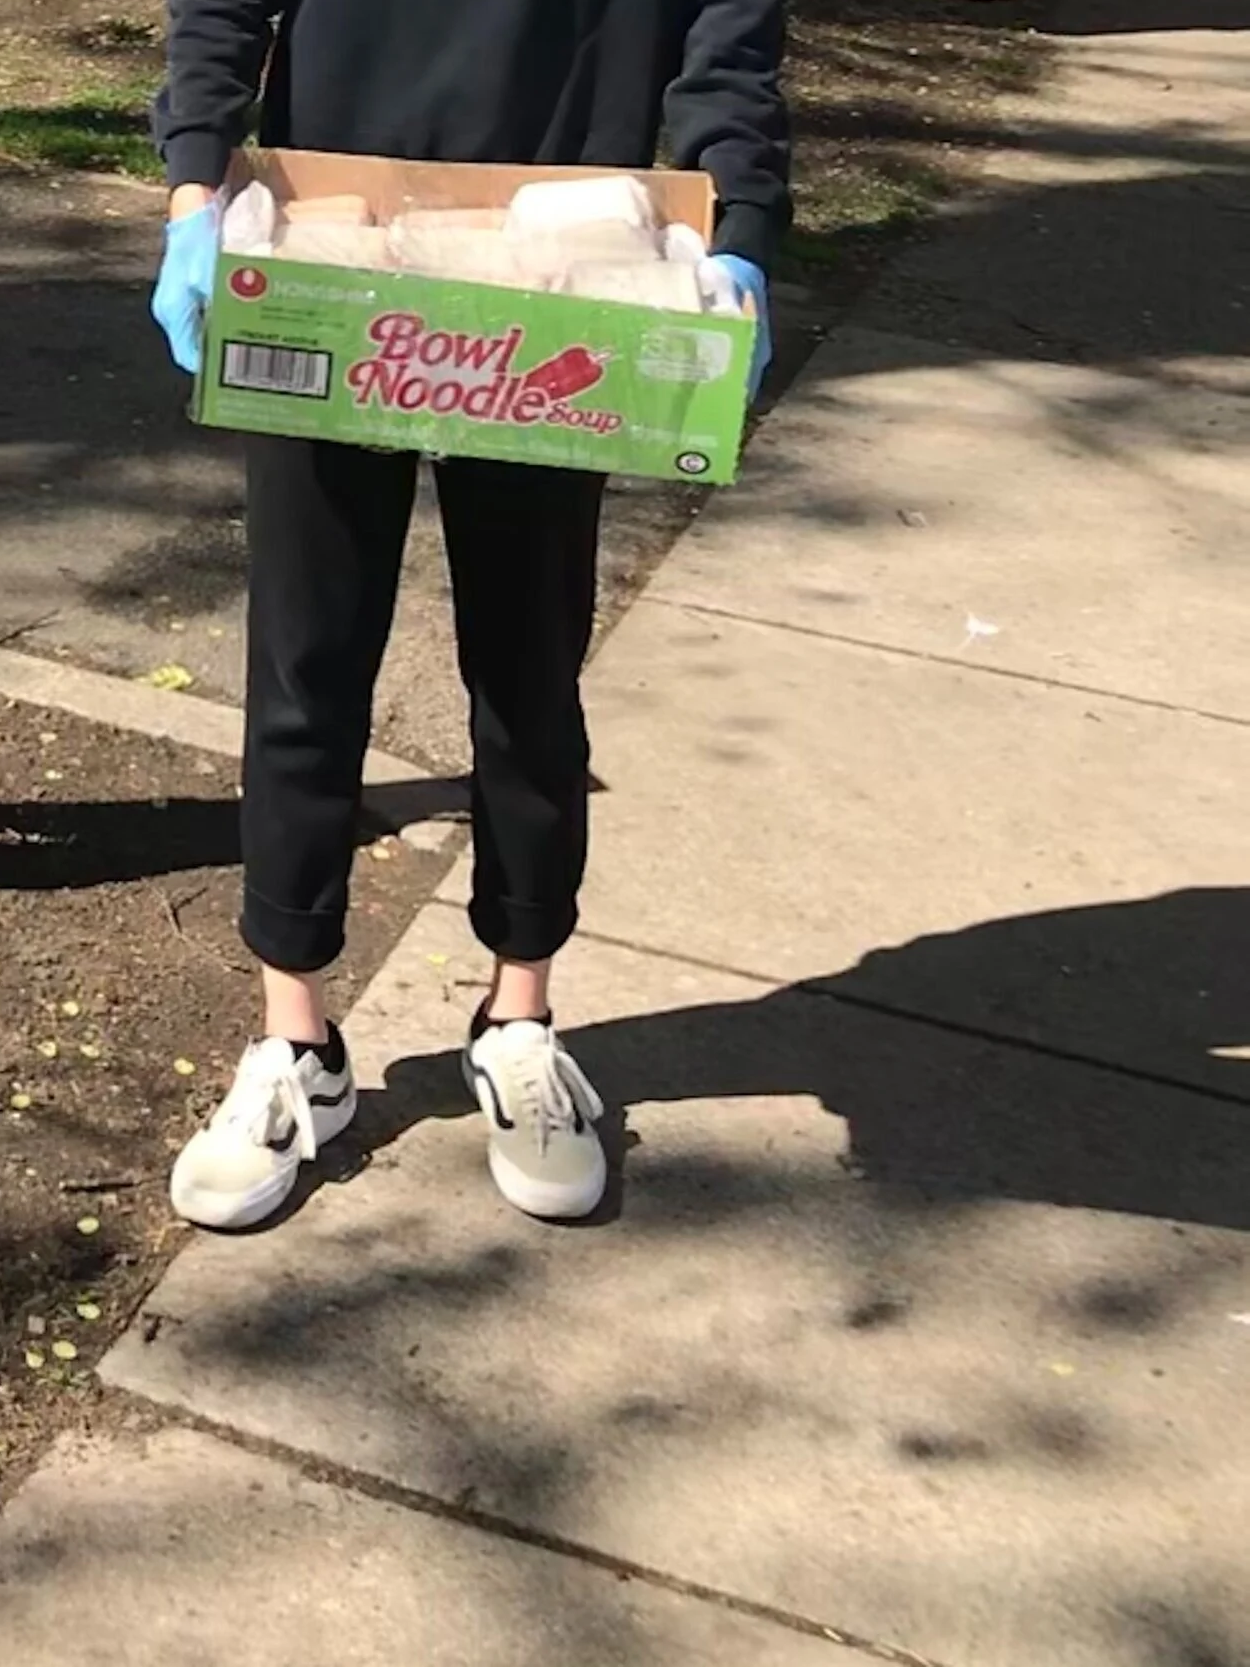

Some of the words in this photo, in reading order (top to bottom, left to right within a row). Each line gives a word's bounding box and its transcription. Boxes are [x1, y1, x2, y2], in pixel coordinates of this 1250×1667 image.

[369, 312, 523, 374] Bowl
[348, 359, 547, 424] Noodle
[546, 400, 622, 433] Soup
